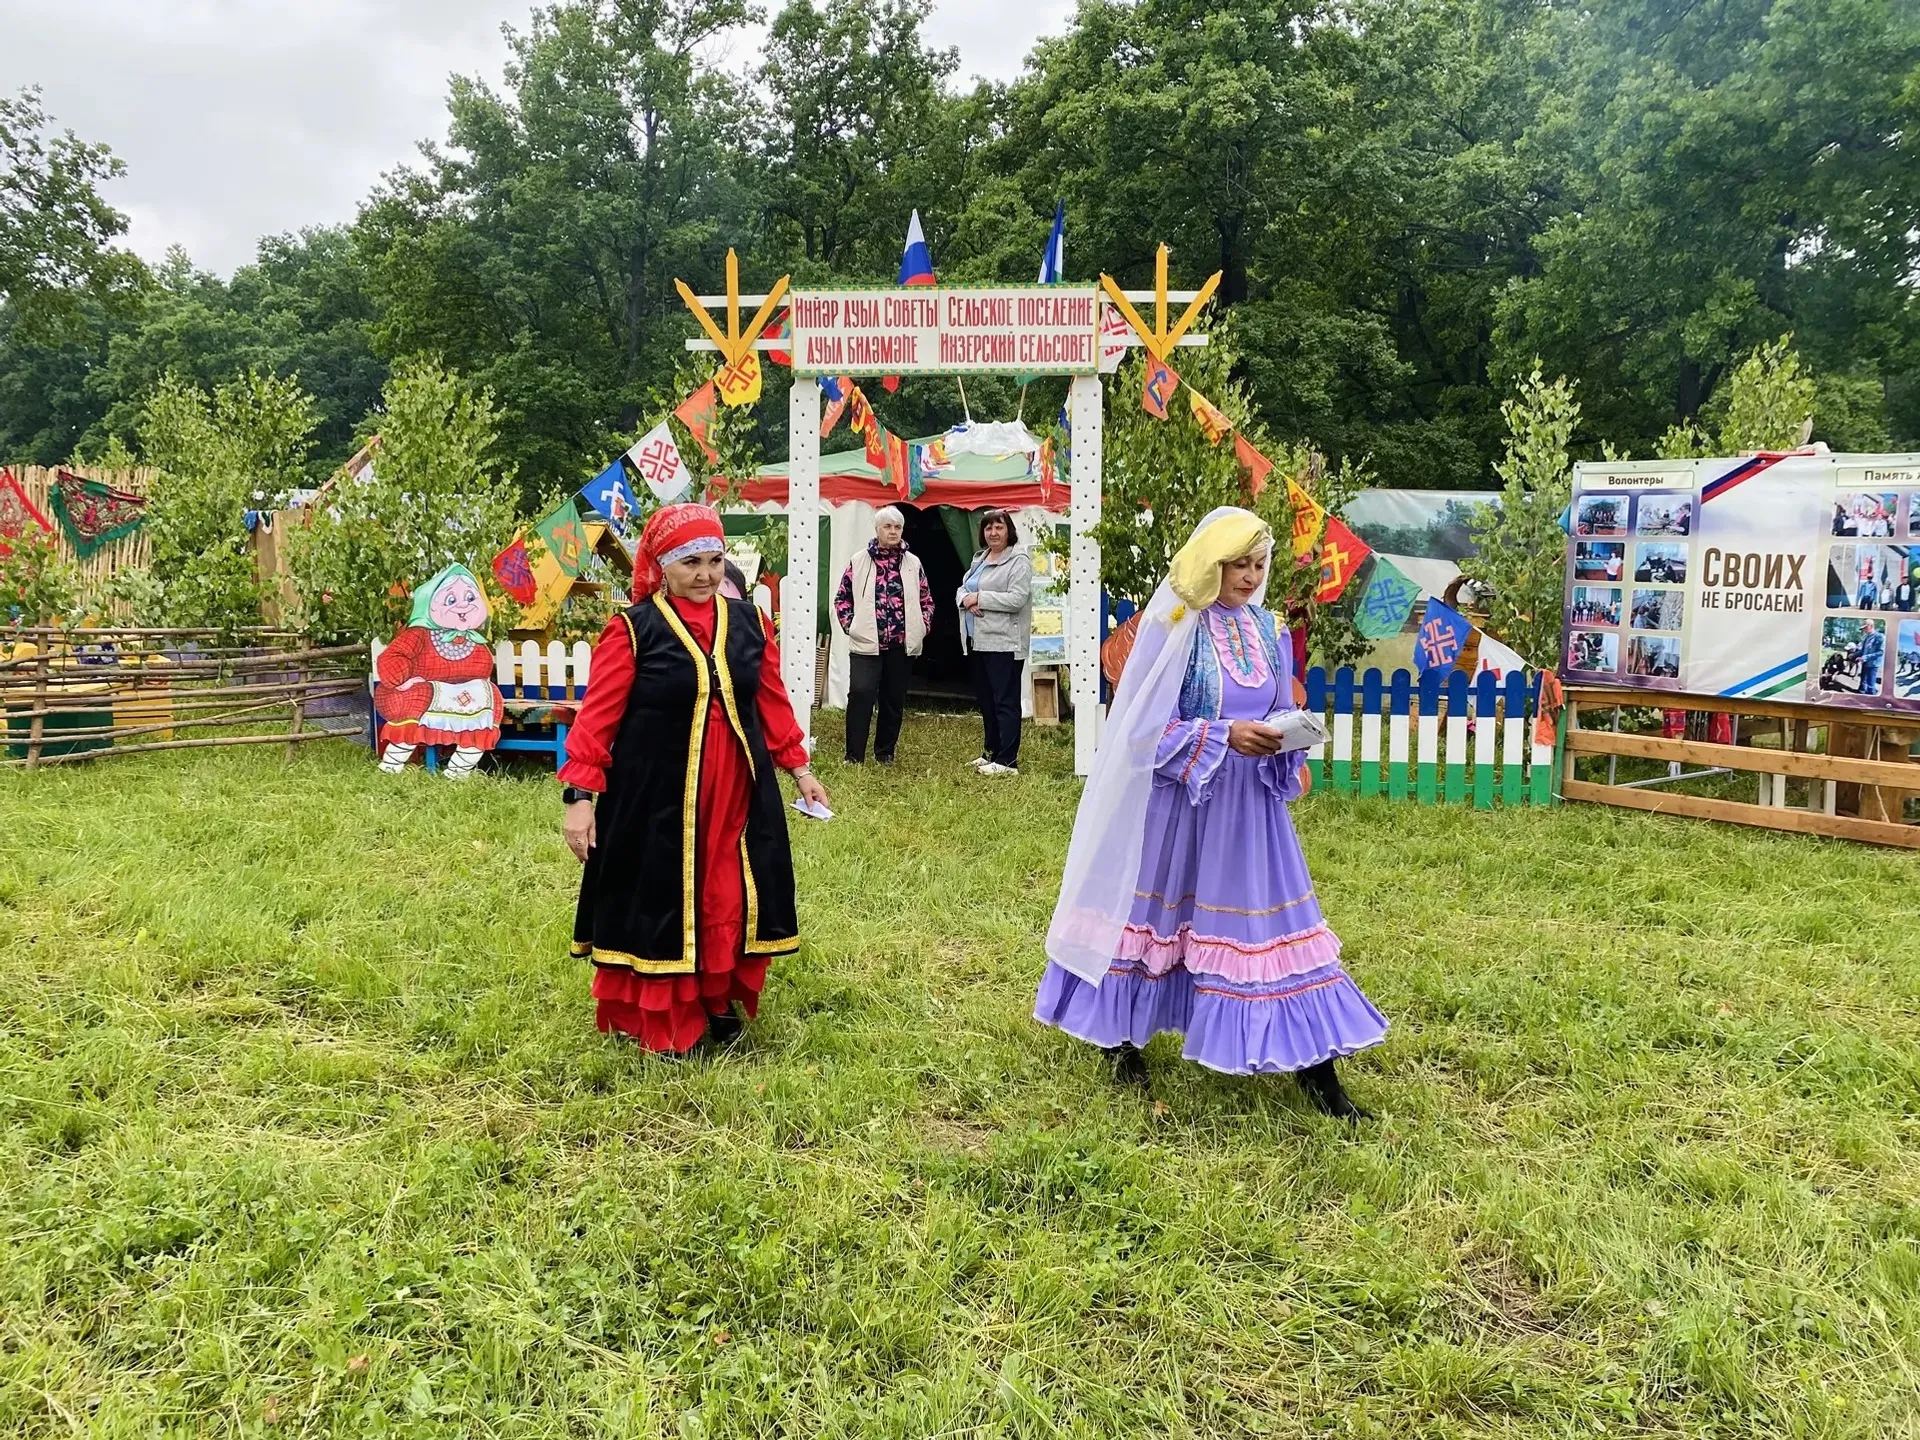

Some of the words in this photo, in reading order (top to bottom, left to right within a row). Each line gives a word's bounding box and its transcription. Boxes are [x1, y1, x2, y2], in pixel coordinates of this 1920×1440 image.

[843, 299, 880, 328] АУЫЛ
[1018, 297, 1094, 326] ПОСЕЛЕНИЕ
[807, 336, 844, 364] АУЫЛ
[1019, 334, 1094, 362] СЕЛЬСОВЕТ
[1608, 476, 1664, 487] Волонтеры
[1864, 470, 1913, 481] Память
[1701, 591, 1720, 608] НЕ
[1724, 592, 1803, 613] БРОСАЕМ!
